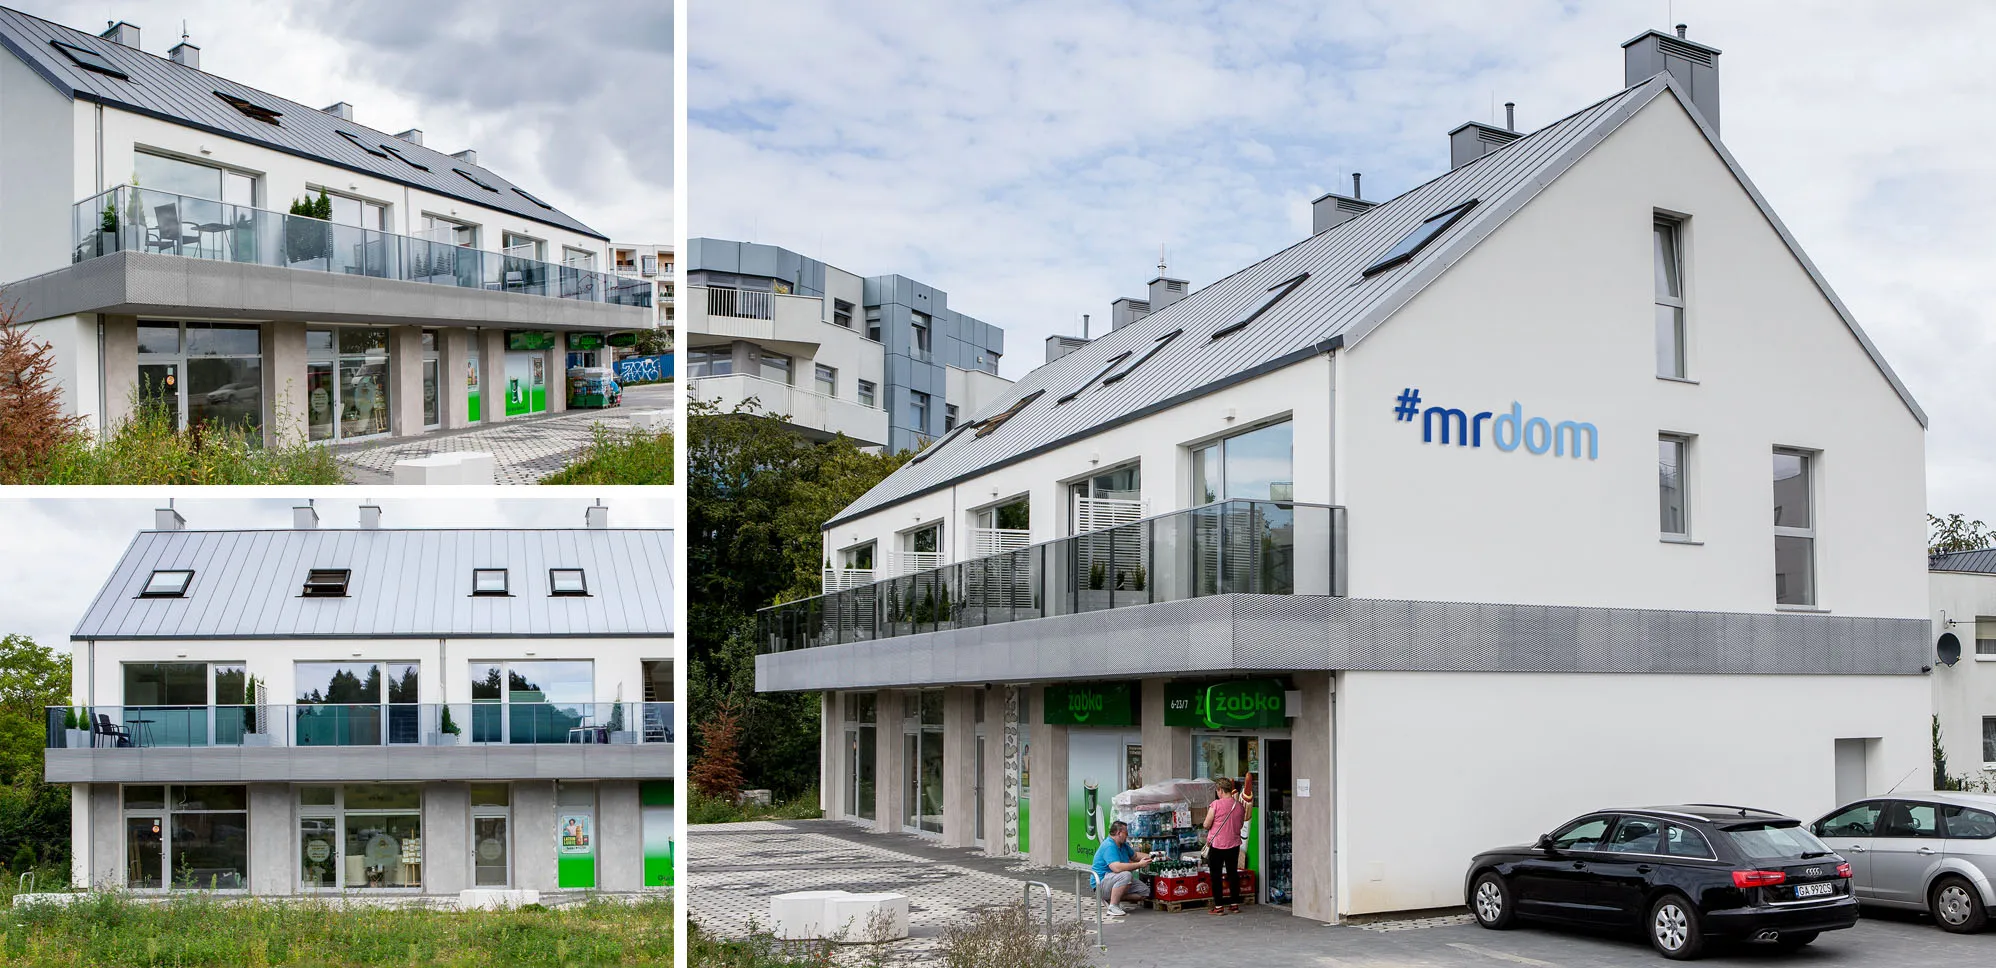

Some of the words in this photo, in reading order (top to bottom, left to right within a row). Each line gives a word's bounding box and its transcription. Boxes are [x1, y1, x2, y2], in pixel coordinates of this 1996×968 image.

[1394, 388, 1599, 460] #mrdom
[1068, 688, 1103, 711] żabka
[1215, 692, 1280, 712] żabka
[1799, 886, 1810, 896] GA
[1811, 884, 1832, 894] 992CS
